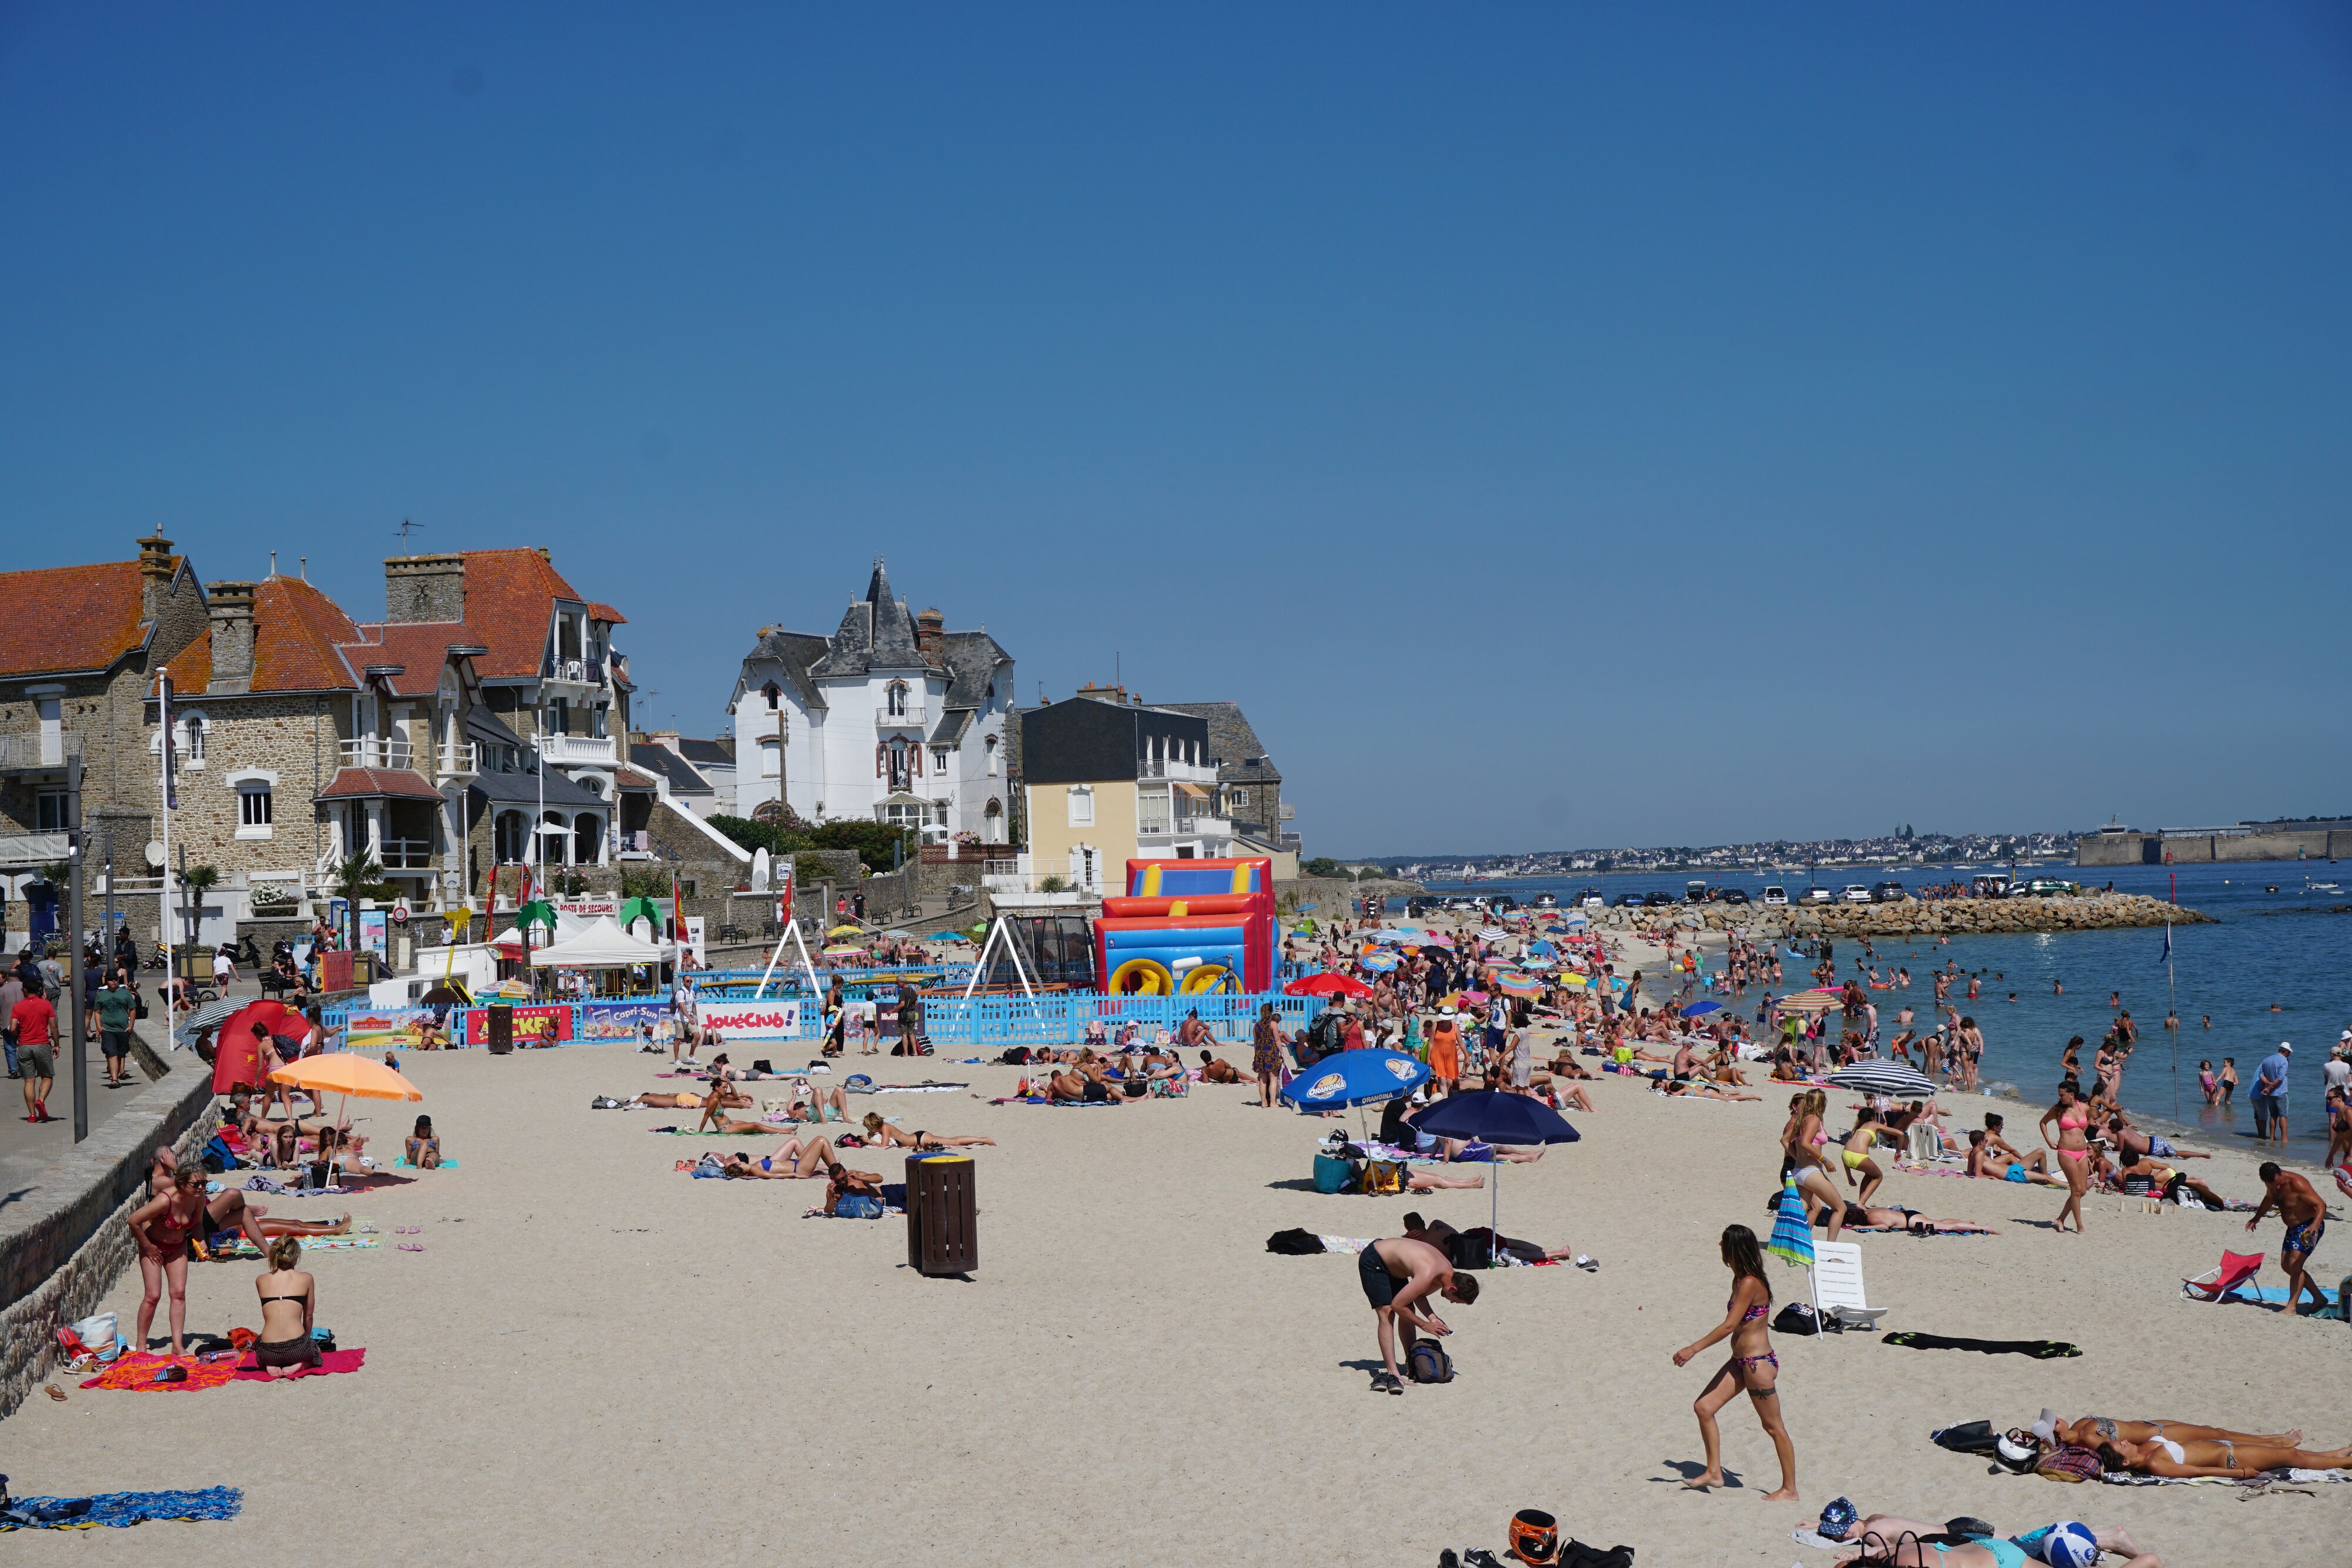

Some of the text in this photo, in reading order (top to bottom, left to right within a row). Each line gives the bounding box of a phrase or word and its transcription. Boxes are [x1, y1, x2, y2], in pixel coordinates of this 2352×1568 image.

[613, 1006, 658, 1021] Capri-Sun
[1308, 1081, 1345, 1096] ORANGINA
[1361, 1092, 1394, 1104] ORANGINA
